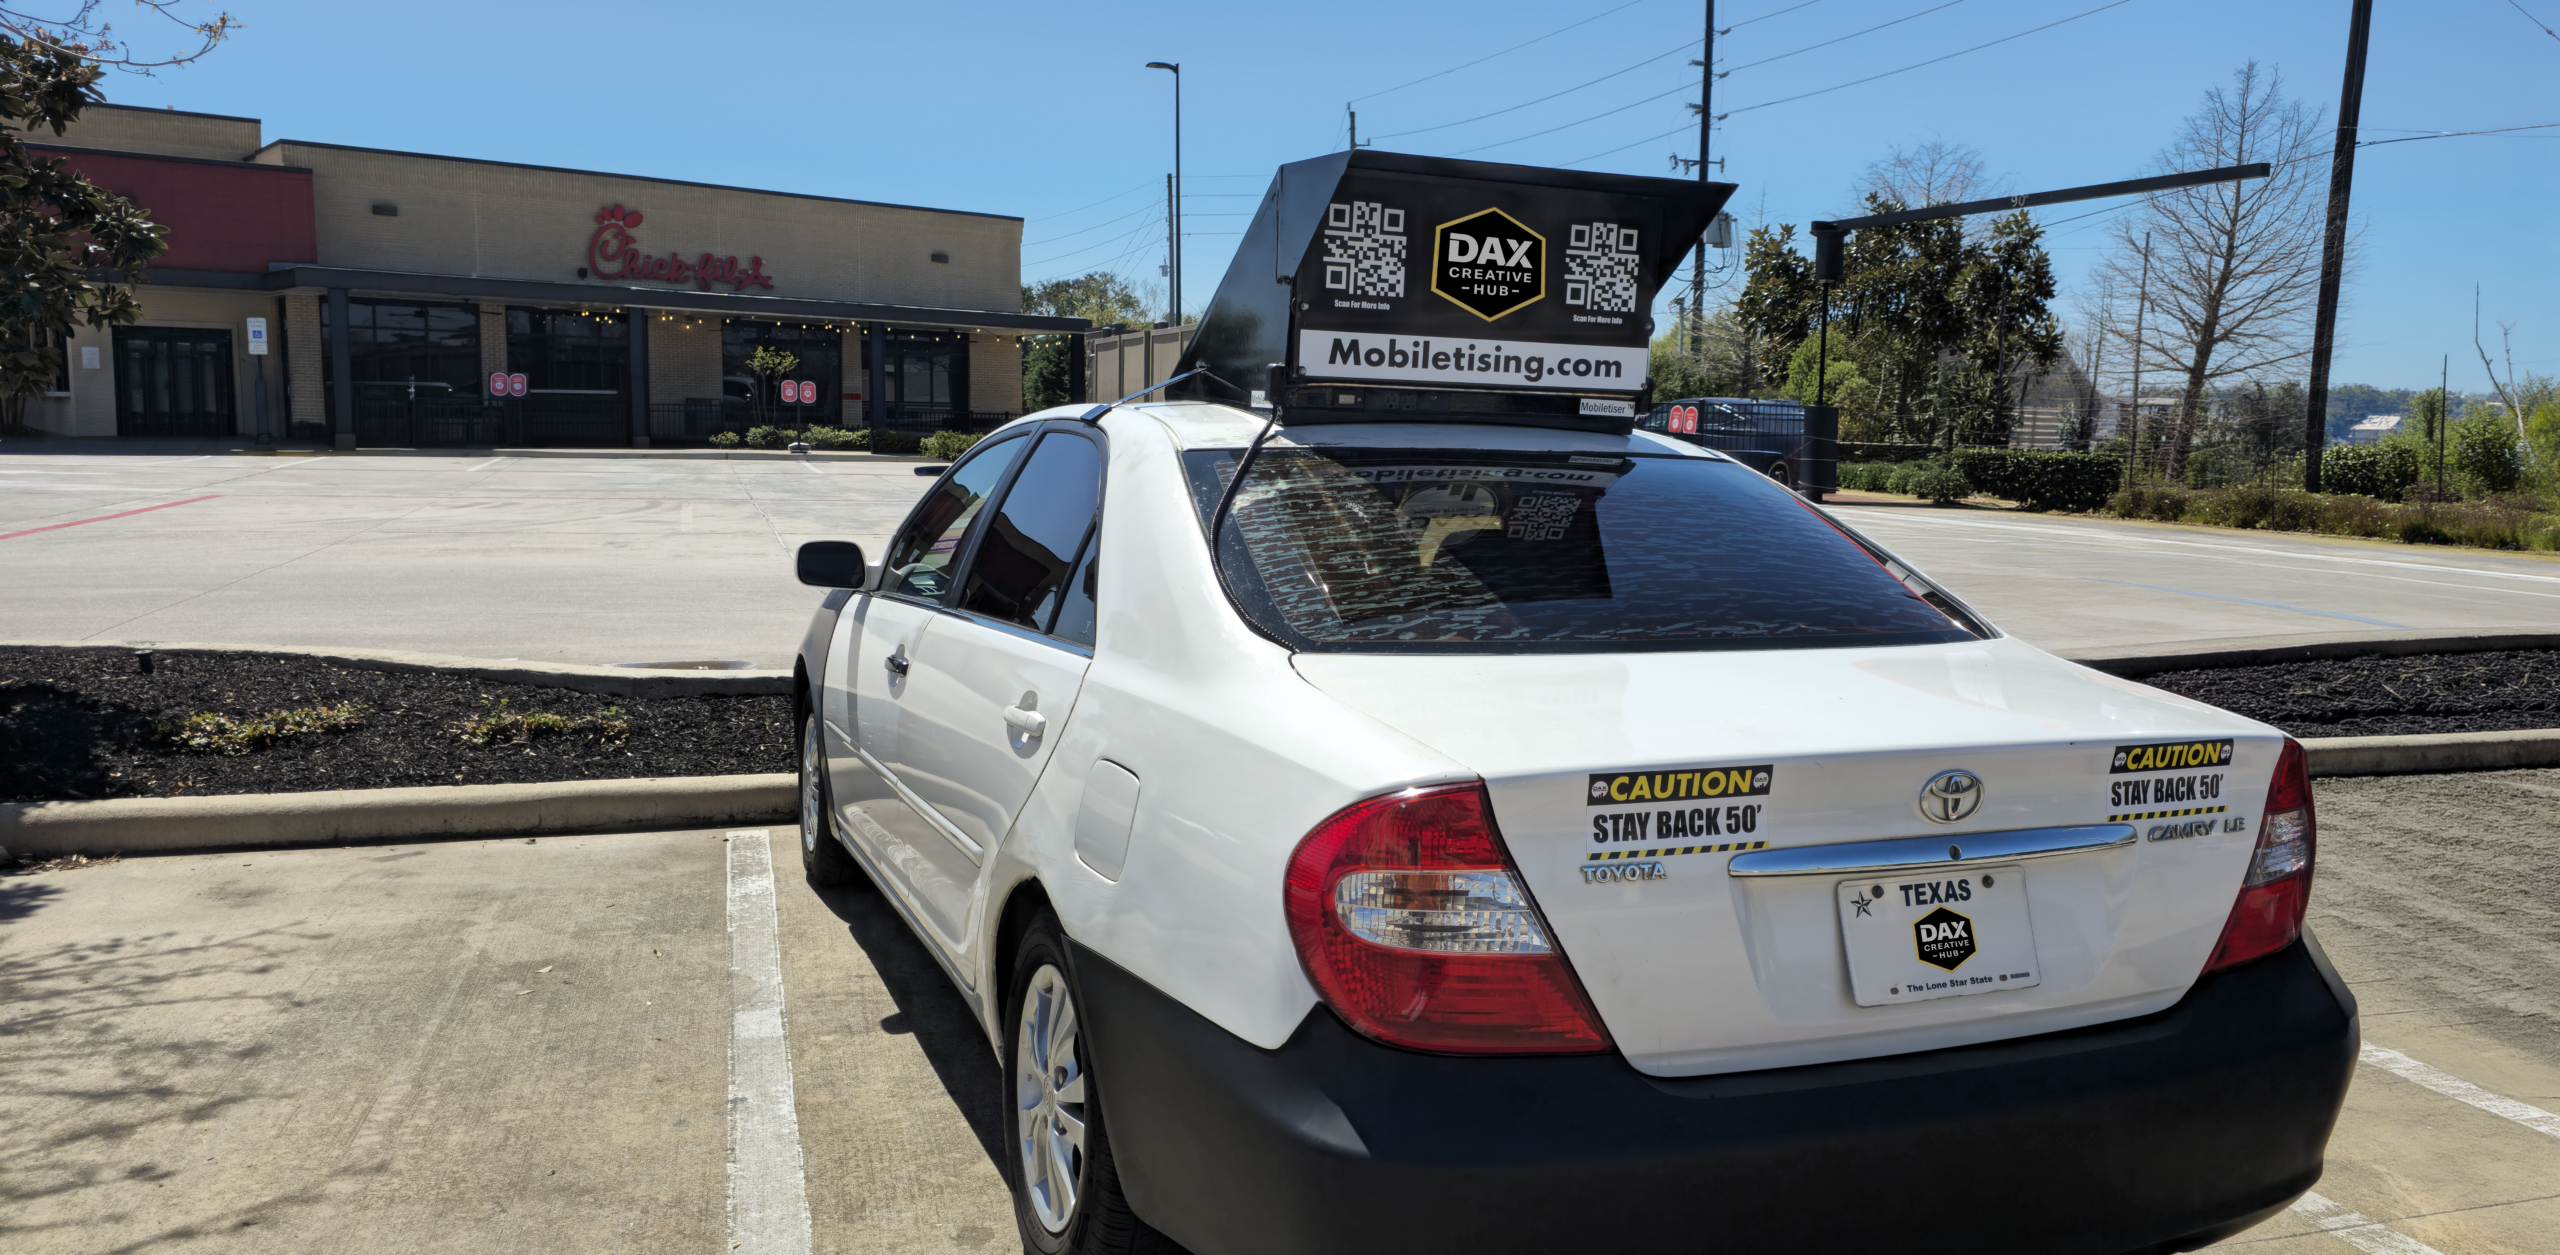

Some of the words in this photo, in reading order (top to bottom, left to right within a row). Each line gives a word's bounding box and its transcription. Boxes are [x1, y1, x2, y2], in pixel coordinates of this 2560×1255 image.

[588, 222, 775, 291] Chick-fil-A
[1448, 232, 1533, 269] DAX
[1448, 267, 1532, 283] CREATIVE
[1334, 299, 1350, 308] Scan
[1351, 300, 1360, 309] For
[1361, 301, 1377, 310] More
[1378, 302, 1391, 311] Info
[1573, 314, 1587, 322] Scan
[1588, 315, 1597, 323] For
[1597, 316, 1611, 324] More
[1612, 317, 1623, 325] Info
[1328, 338, 1622, 382] Mobiletising.com
[1581, 402, 1626, 414] Mobiletiser
[2126, 742, 2221, 770] CAUTION
[1610, 769, 1752, 801] CAUTION
[2111, 779, 2151, 807] STAY
[2154, 775, 2197, 804] BACK
[2200, 773, 2224, 799] 50'
[1593, 812, 1651, 844] STAY
[1656, 807, 1721, 839] BACK
[1726, 804, 1762, 834] 50'
[2147, 820, 2218, 843] CAMRY
[2223, 817, 2246, 834] LE
[1580, 862, 1667, 884] TOYOTA
[1899, 879, 1972, 907] TEXAS
[1919, 920, 1968, 943] DAX
[1924, 939, 1970, 952] CREATIVE
[1906, 984, 1924, 993] The
[1926, 981, 1947, 990] Lone
[1949, 979, 1968, 988] Star
[1970, 976, 1993, 985] State
